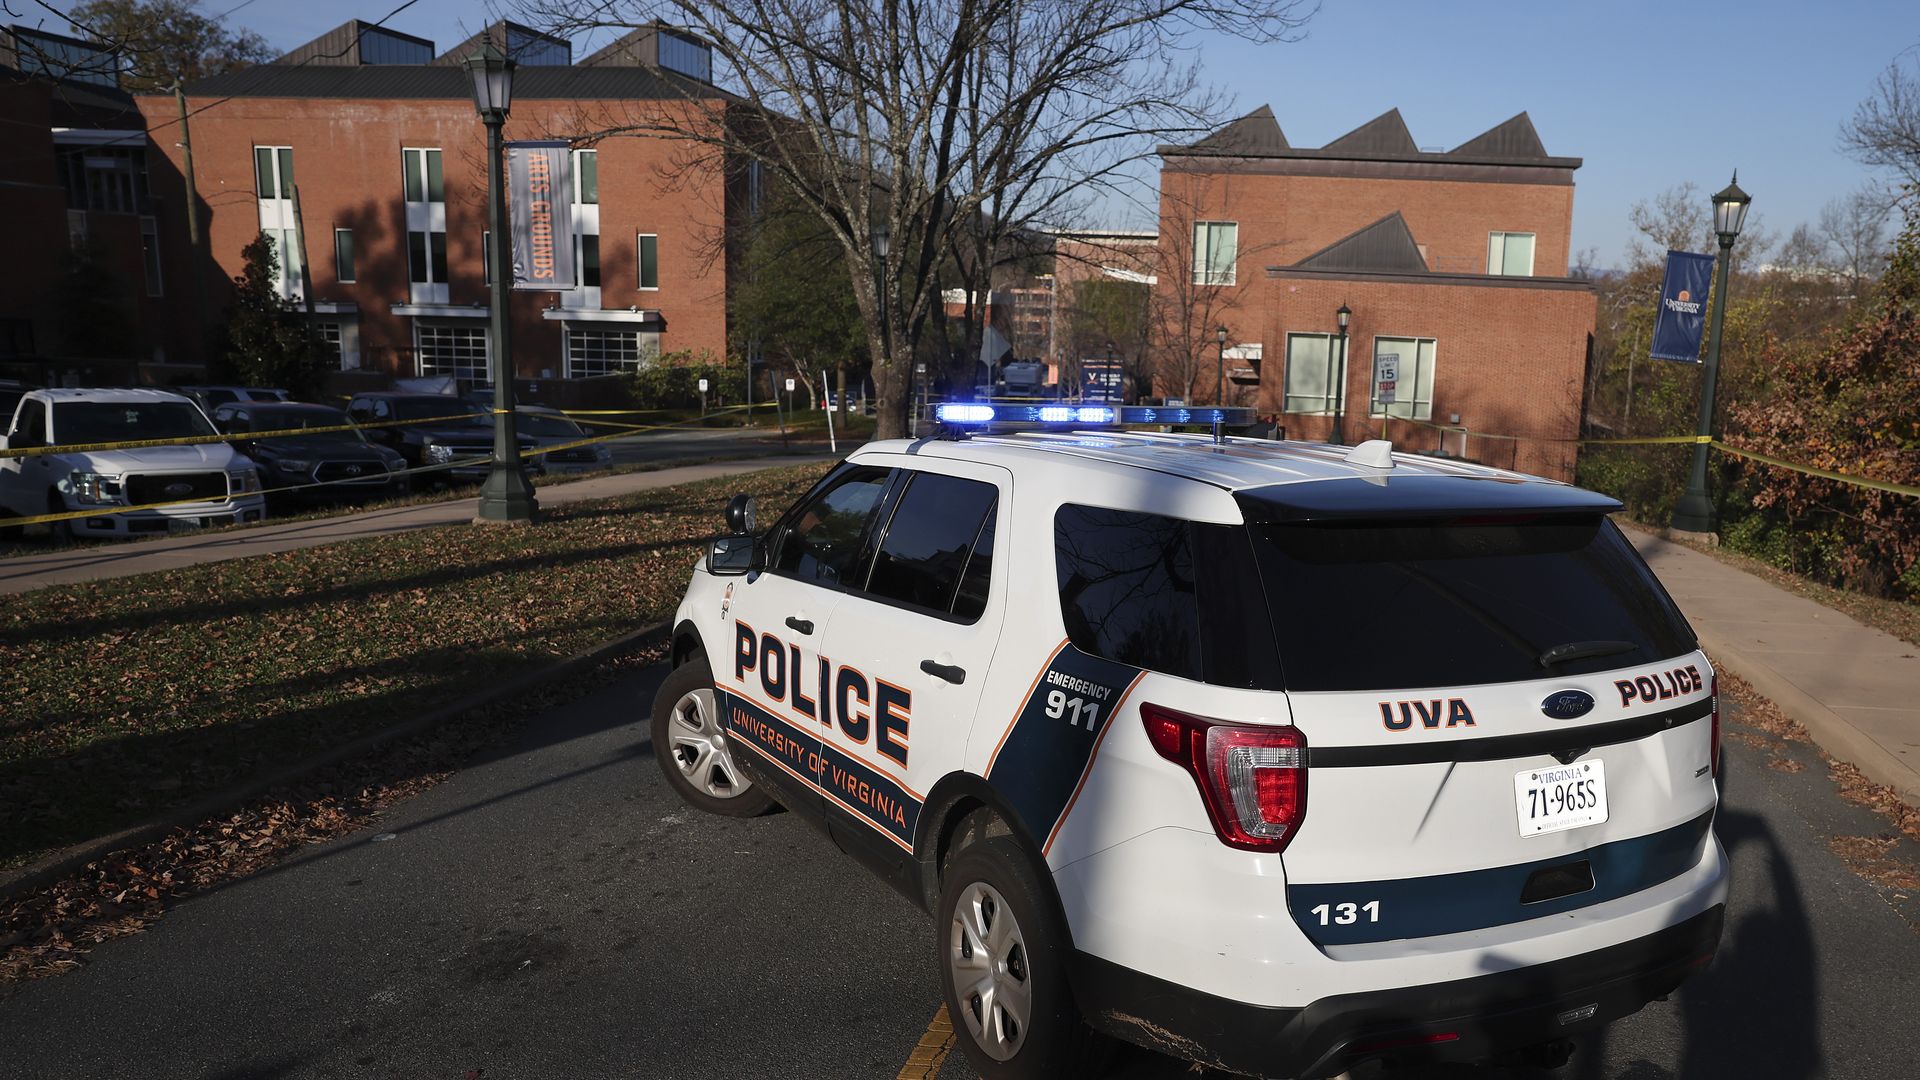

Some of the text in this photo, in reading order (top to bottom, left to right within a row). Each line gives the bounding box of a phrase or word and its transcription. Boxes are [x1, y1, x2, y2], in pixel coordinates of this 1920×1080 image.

[528, 152, 554, 279] ARTS GROUNDS
[1381, 369, 1394, 379] 15
[735, 618, 912, 769] POLICE
[1046, 670, 1112, 701] EMERGENCY
[1556, 695, 1586, 713] Ford
[1613, 664, 1703, 708] POLICE
[1045, 689, 1100, 732] 911
[1378, 698, 1478, 732] UVA
[733, 707, 907, 829] UNIVERSITY OF VIRGINIA
[1538, 767, 1582, 784] VIRGINIA
[1528, 779, 1597, 819] 71-965S
[1310, 900, 1380, 926] 131
